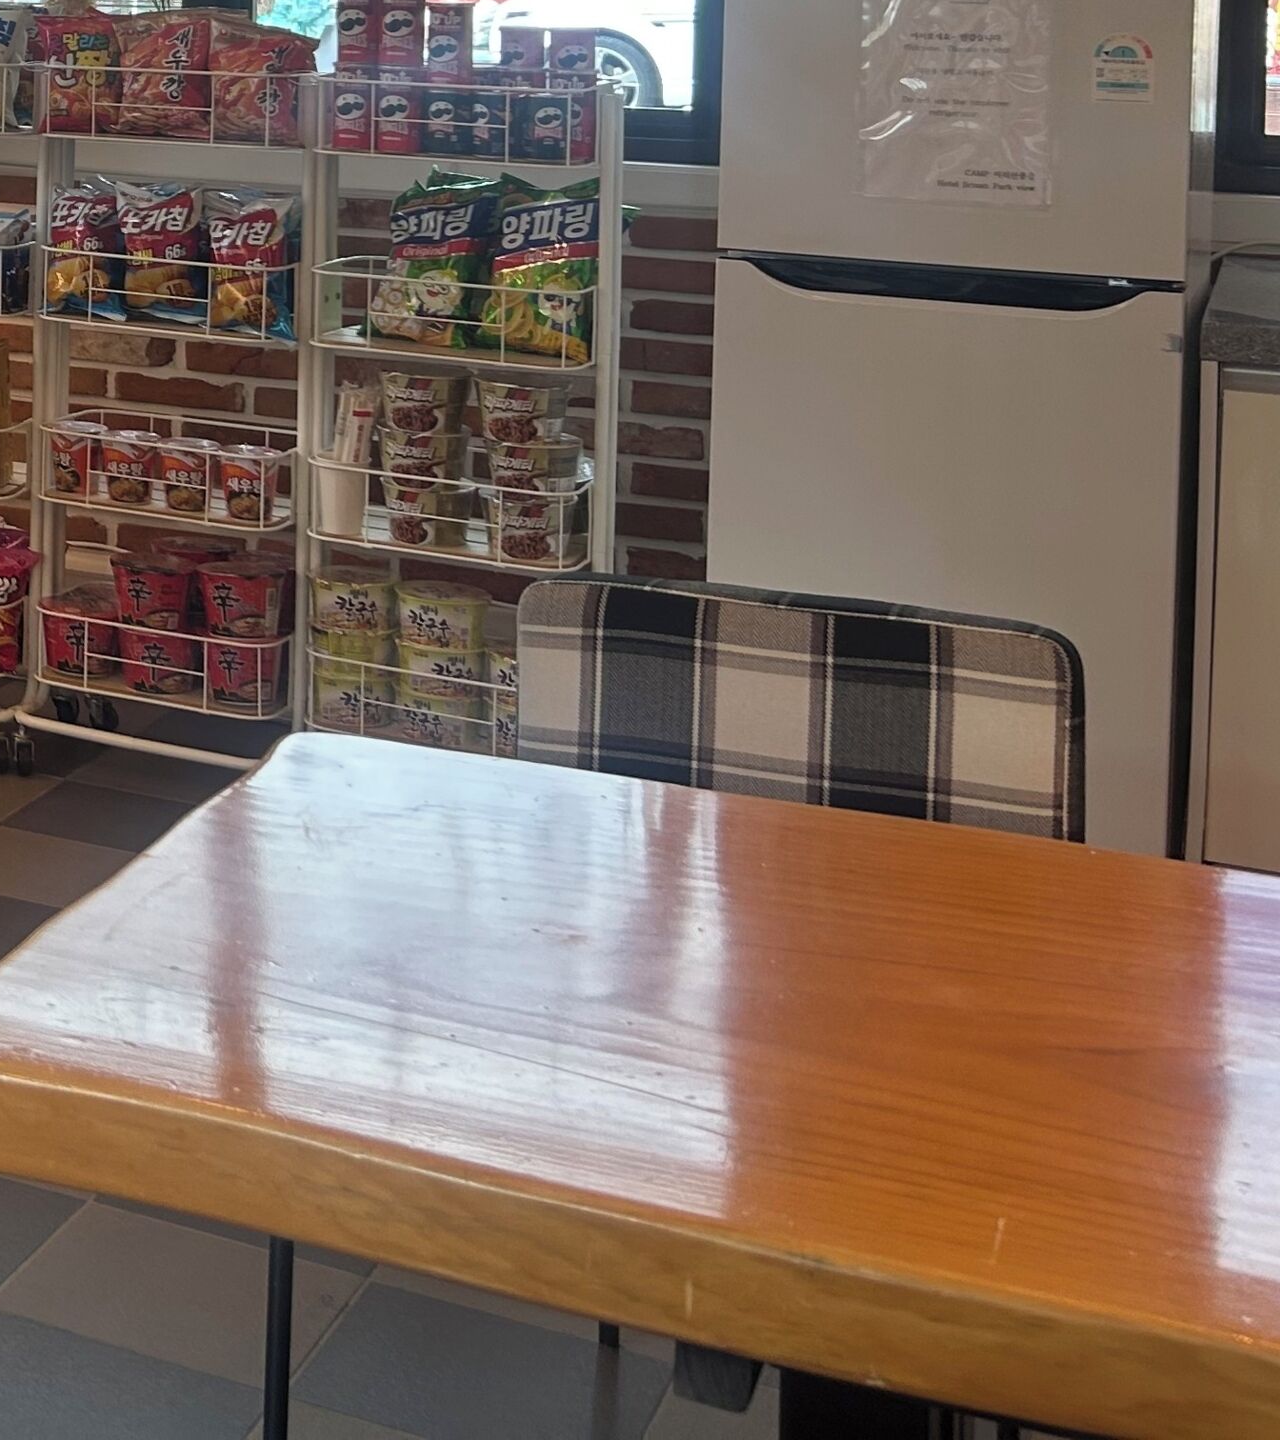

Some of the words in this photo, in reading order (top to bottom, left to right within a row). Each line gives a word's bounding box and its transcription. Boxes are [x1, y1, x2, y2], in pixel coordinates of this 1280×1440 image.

[160, 24, 194, 101] 새우깡
[121, 205, 189, 234] 포카칩
[208, 219, 273, 247] 포카칩
[391, 204, 474, 244] 양파링
[502, 204, 593, 250] 양파링
[402, 244, 448, 258] Original
[385, 385, 435, 403] 짜파게티
[483, 394, 536, 412] 짜파게티
[385, 441, 435, 460] 짜파게티
[128, 577, 152, 612] 辛
[212, 583, 241, 623] 辛
[217, 648, 245, 685] 辛
